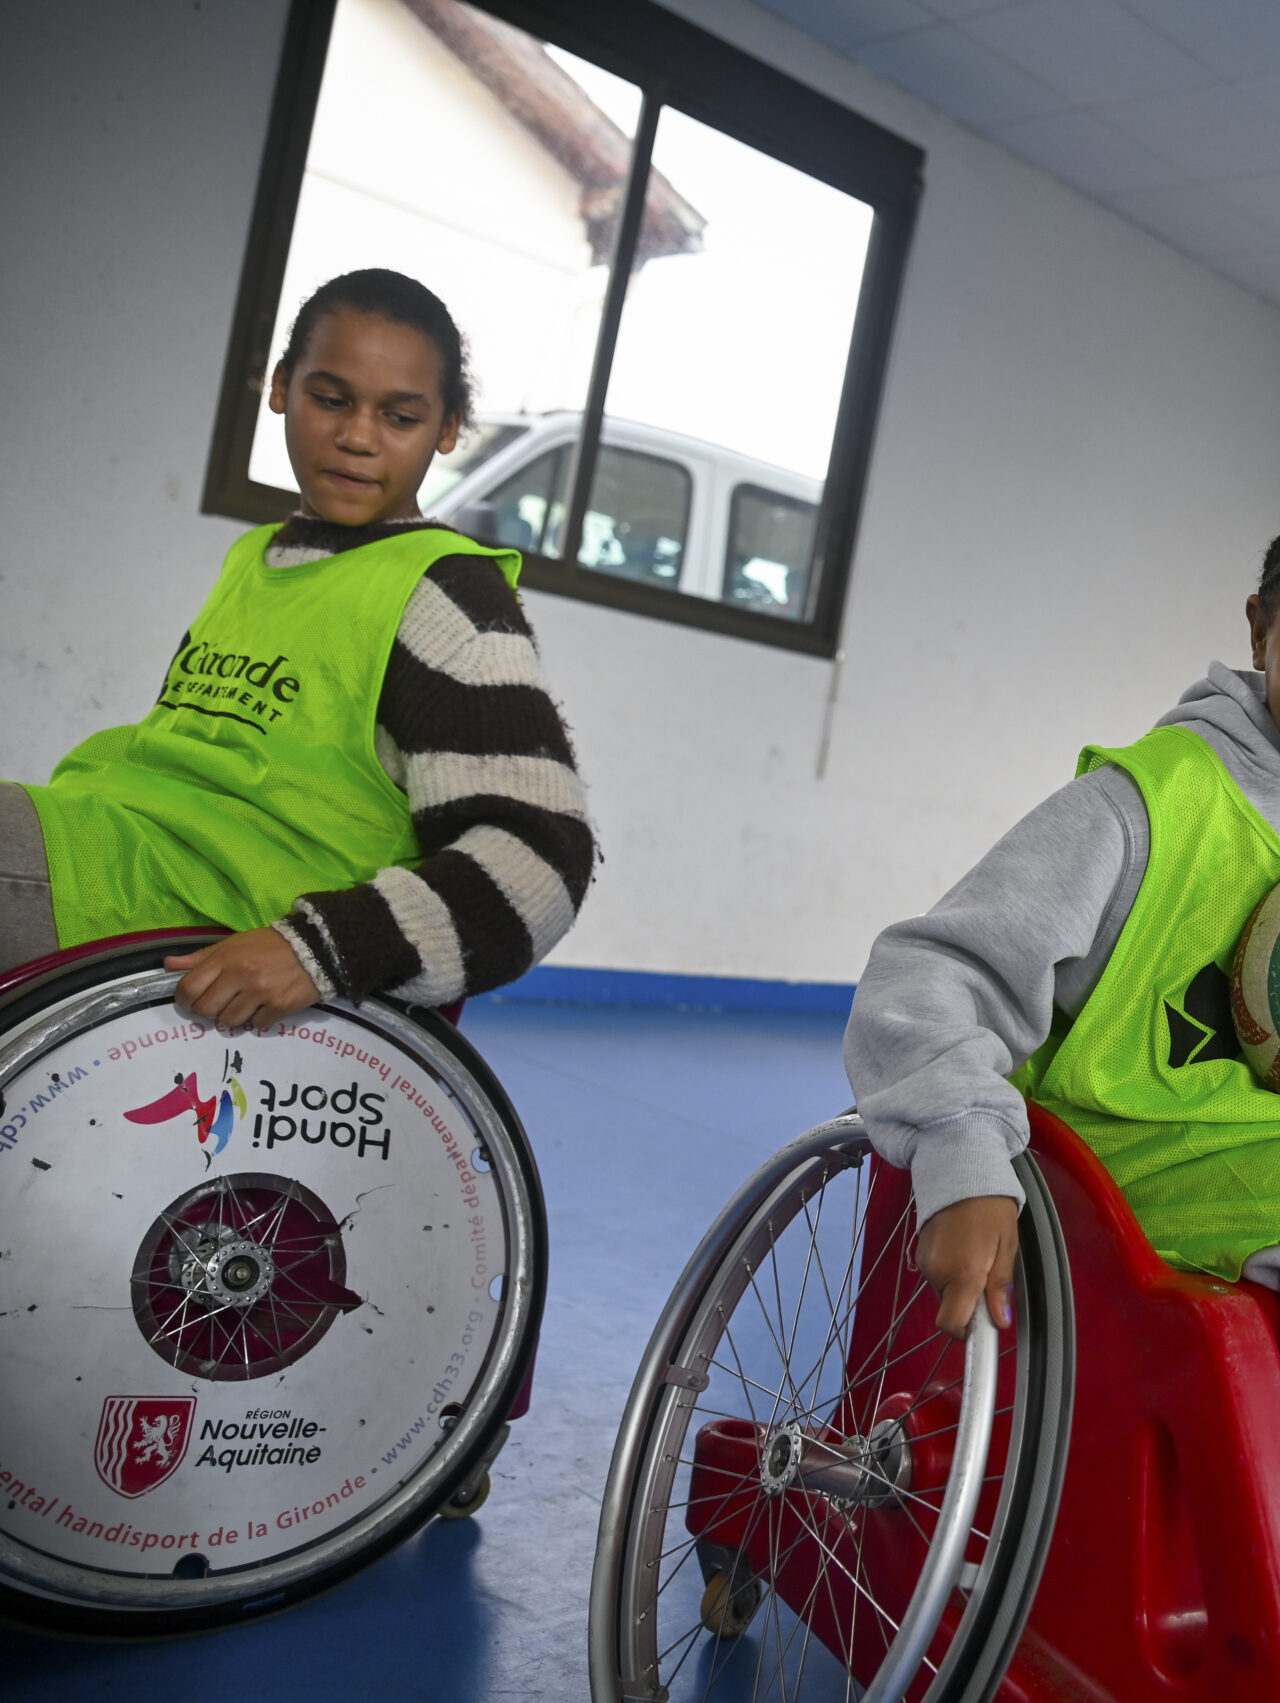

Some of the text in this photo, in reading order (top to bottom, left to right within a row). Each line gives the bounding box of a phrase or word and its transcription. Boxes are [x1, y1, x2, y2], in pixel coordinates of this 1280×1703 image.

[106, 1021, 206, 1063] Gironde
[277, 1021, 394, 1076] handisport
[259, 1080, 386, 1126] Sport
[251, 1113, 392, 1162] Handi
[389, 1071, 481, 1211] départemental
[470, 1214, 488, 1290] Comité
[381, 1309, 484, 1466] www.cdh33.org
[199, 1418, 327, 1443] Nouvelle-
[245, 1407, 292, 1421] RÉGION
[195, 1442, 322, 1474] Aquitaine
[55, 1503, 200, 1553] handisport
[207, 1526, 240, 1547] de
[247, 1520, 269, 1541] la
[276, 1474, 367, 1531] Gironde
